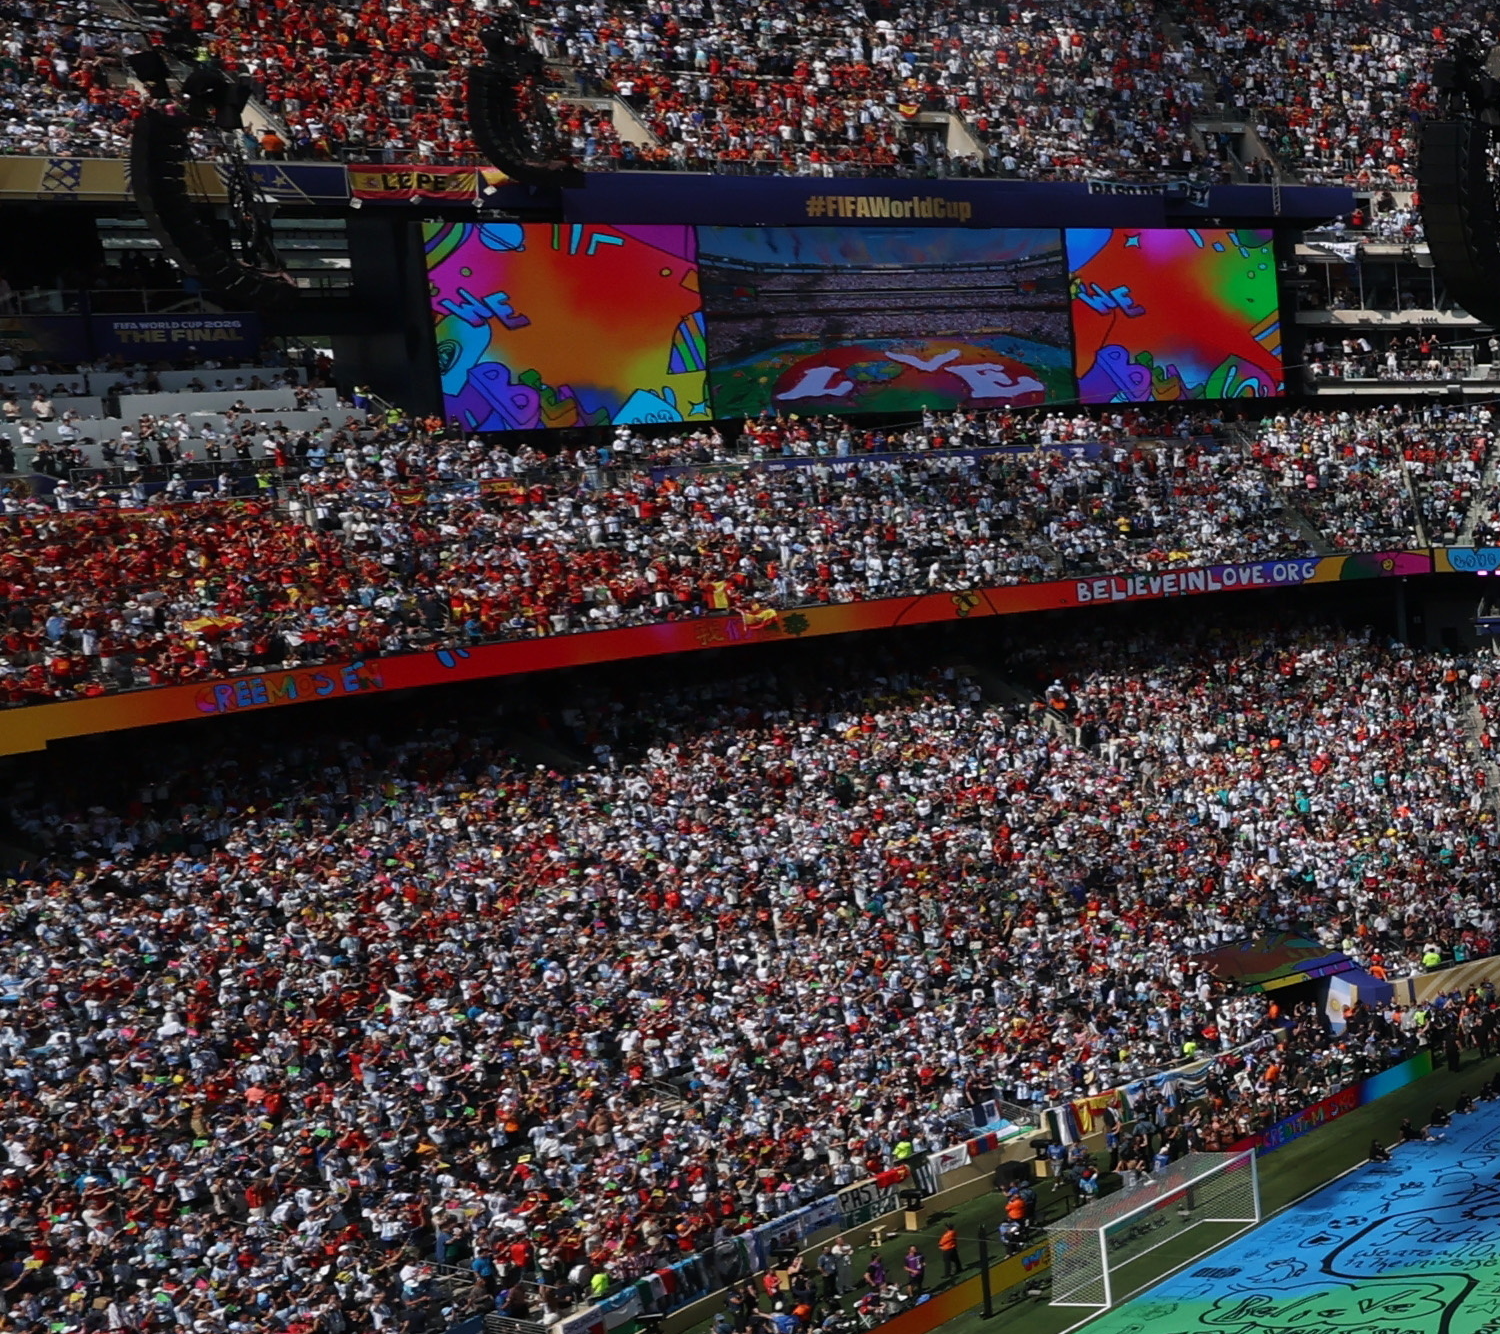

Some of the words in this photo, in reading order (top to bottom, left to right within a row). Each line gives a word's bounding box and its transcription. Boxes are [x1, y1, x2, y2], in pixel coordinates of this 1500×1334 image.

[806, 196, 972, 222] #FIFAWorldCup
[116, 330, 167, 343] THE
[171, 329, 244, 342] FINAL
[1076, 560, 1317, 603] BELIEVEINLOVE.ORG
